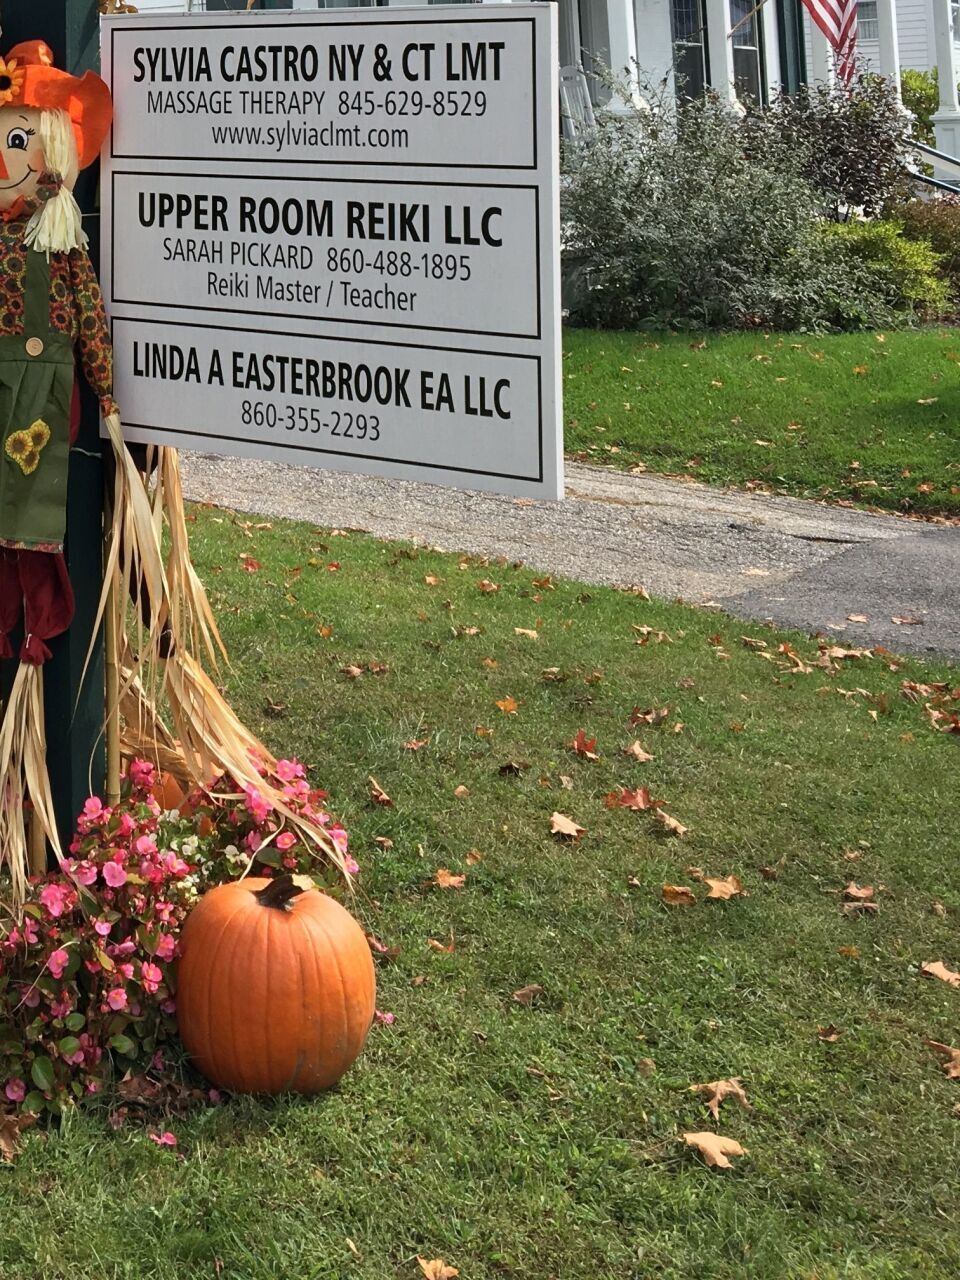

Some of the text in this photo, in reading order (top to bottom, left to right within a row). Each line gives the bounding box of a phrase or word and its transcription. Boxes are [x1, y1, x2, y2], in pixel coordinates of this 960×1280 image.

[133, 41, 506, 83] SYLVIA CASTRO NY & CT LMT
[147, 90, 487, 117] MASSAGE THERAPY 845-629-8529
[211, 119, 409, 153] www.sylviaclmt.com
[138, 191, 503, 248] UPPER ROOM REIKI LLC
[163, 237, 472, 282] SARAH PICKARD 860-488-1895
[207, 271, 249, 298] Reiki
[256, 275, 322, 304] Master
[339, 280, 417, 312] Teacher
[133, 340, 511, 420] LINDA A EASTERBROOK EA LLC
[241, 399, 380, 442] 860-355-2293
